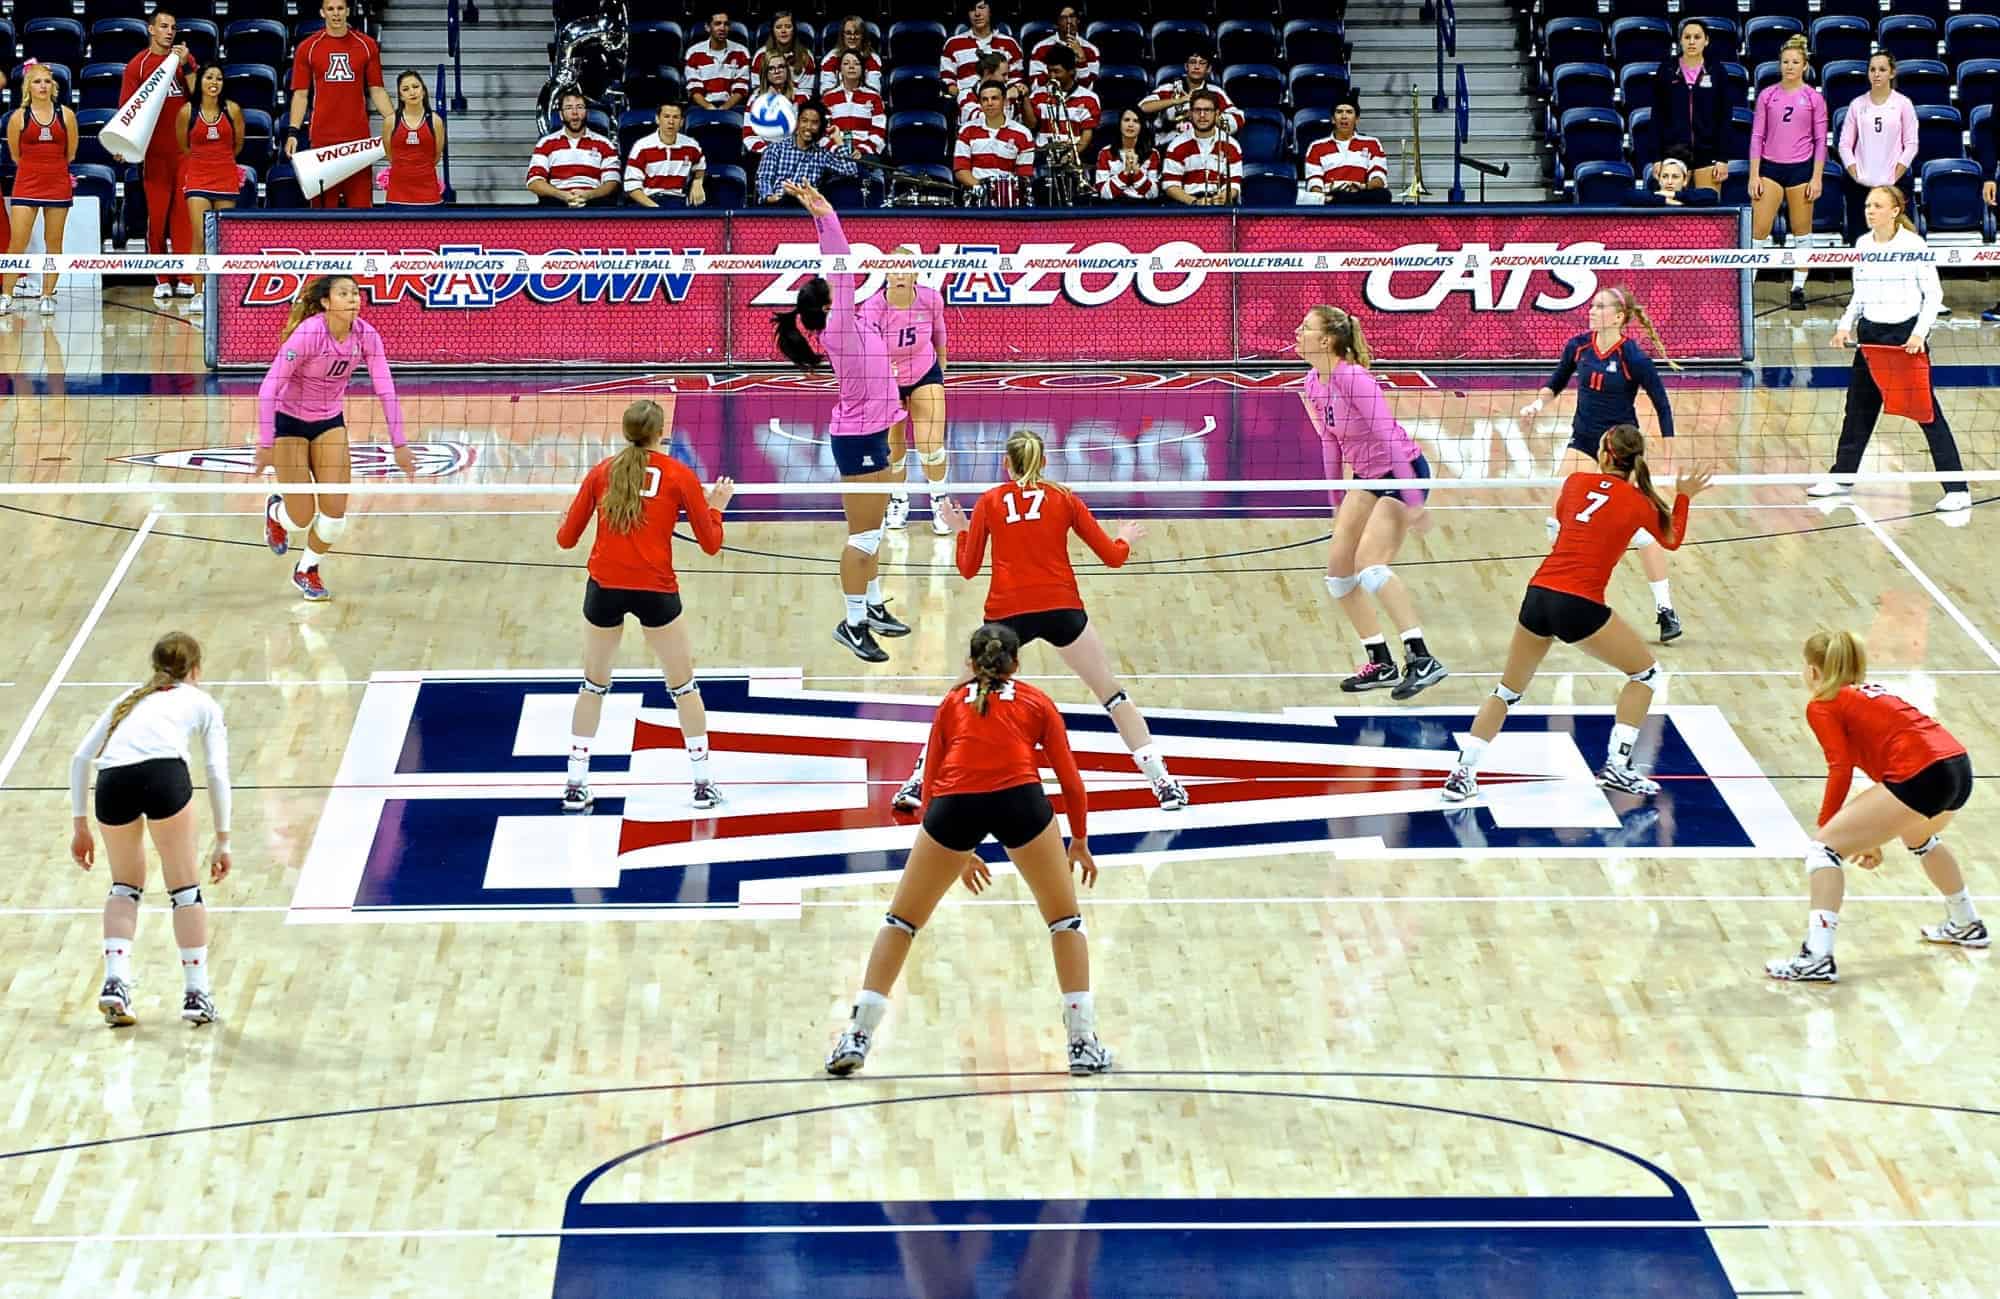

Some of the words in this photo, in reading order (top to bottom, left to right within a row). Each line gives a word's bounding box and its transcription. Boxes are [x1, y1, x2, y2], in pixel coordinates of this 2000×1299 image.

[1782, 106, 1794, 122] 2
[1874, 117, 1882, 132] 5
[316, 137, 382, 162] ARIZONA
[0, 259, 31, 269] BALL
[244, 248, 440, 305] BAR
[1366, 241, 1605, 312] CATS
[898, 327, 917, 347] 15
[327, 360, 349, 376] 10
[1589, 371, 1604, 391] 11
[1003, 489, 1045, 523] 17
[1575, 490, 1610, 523] 7
